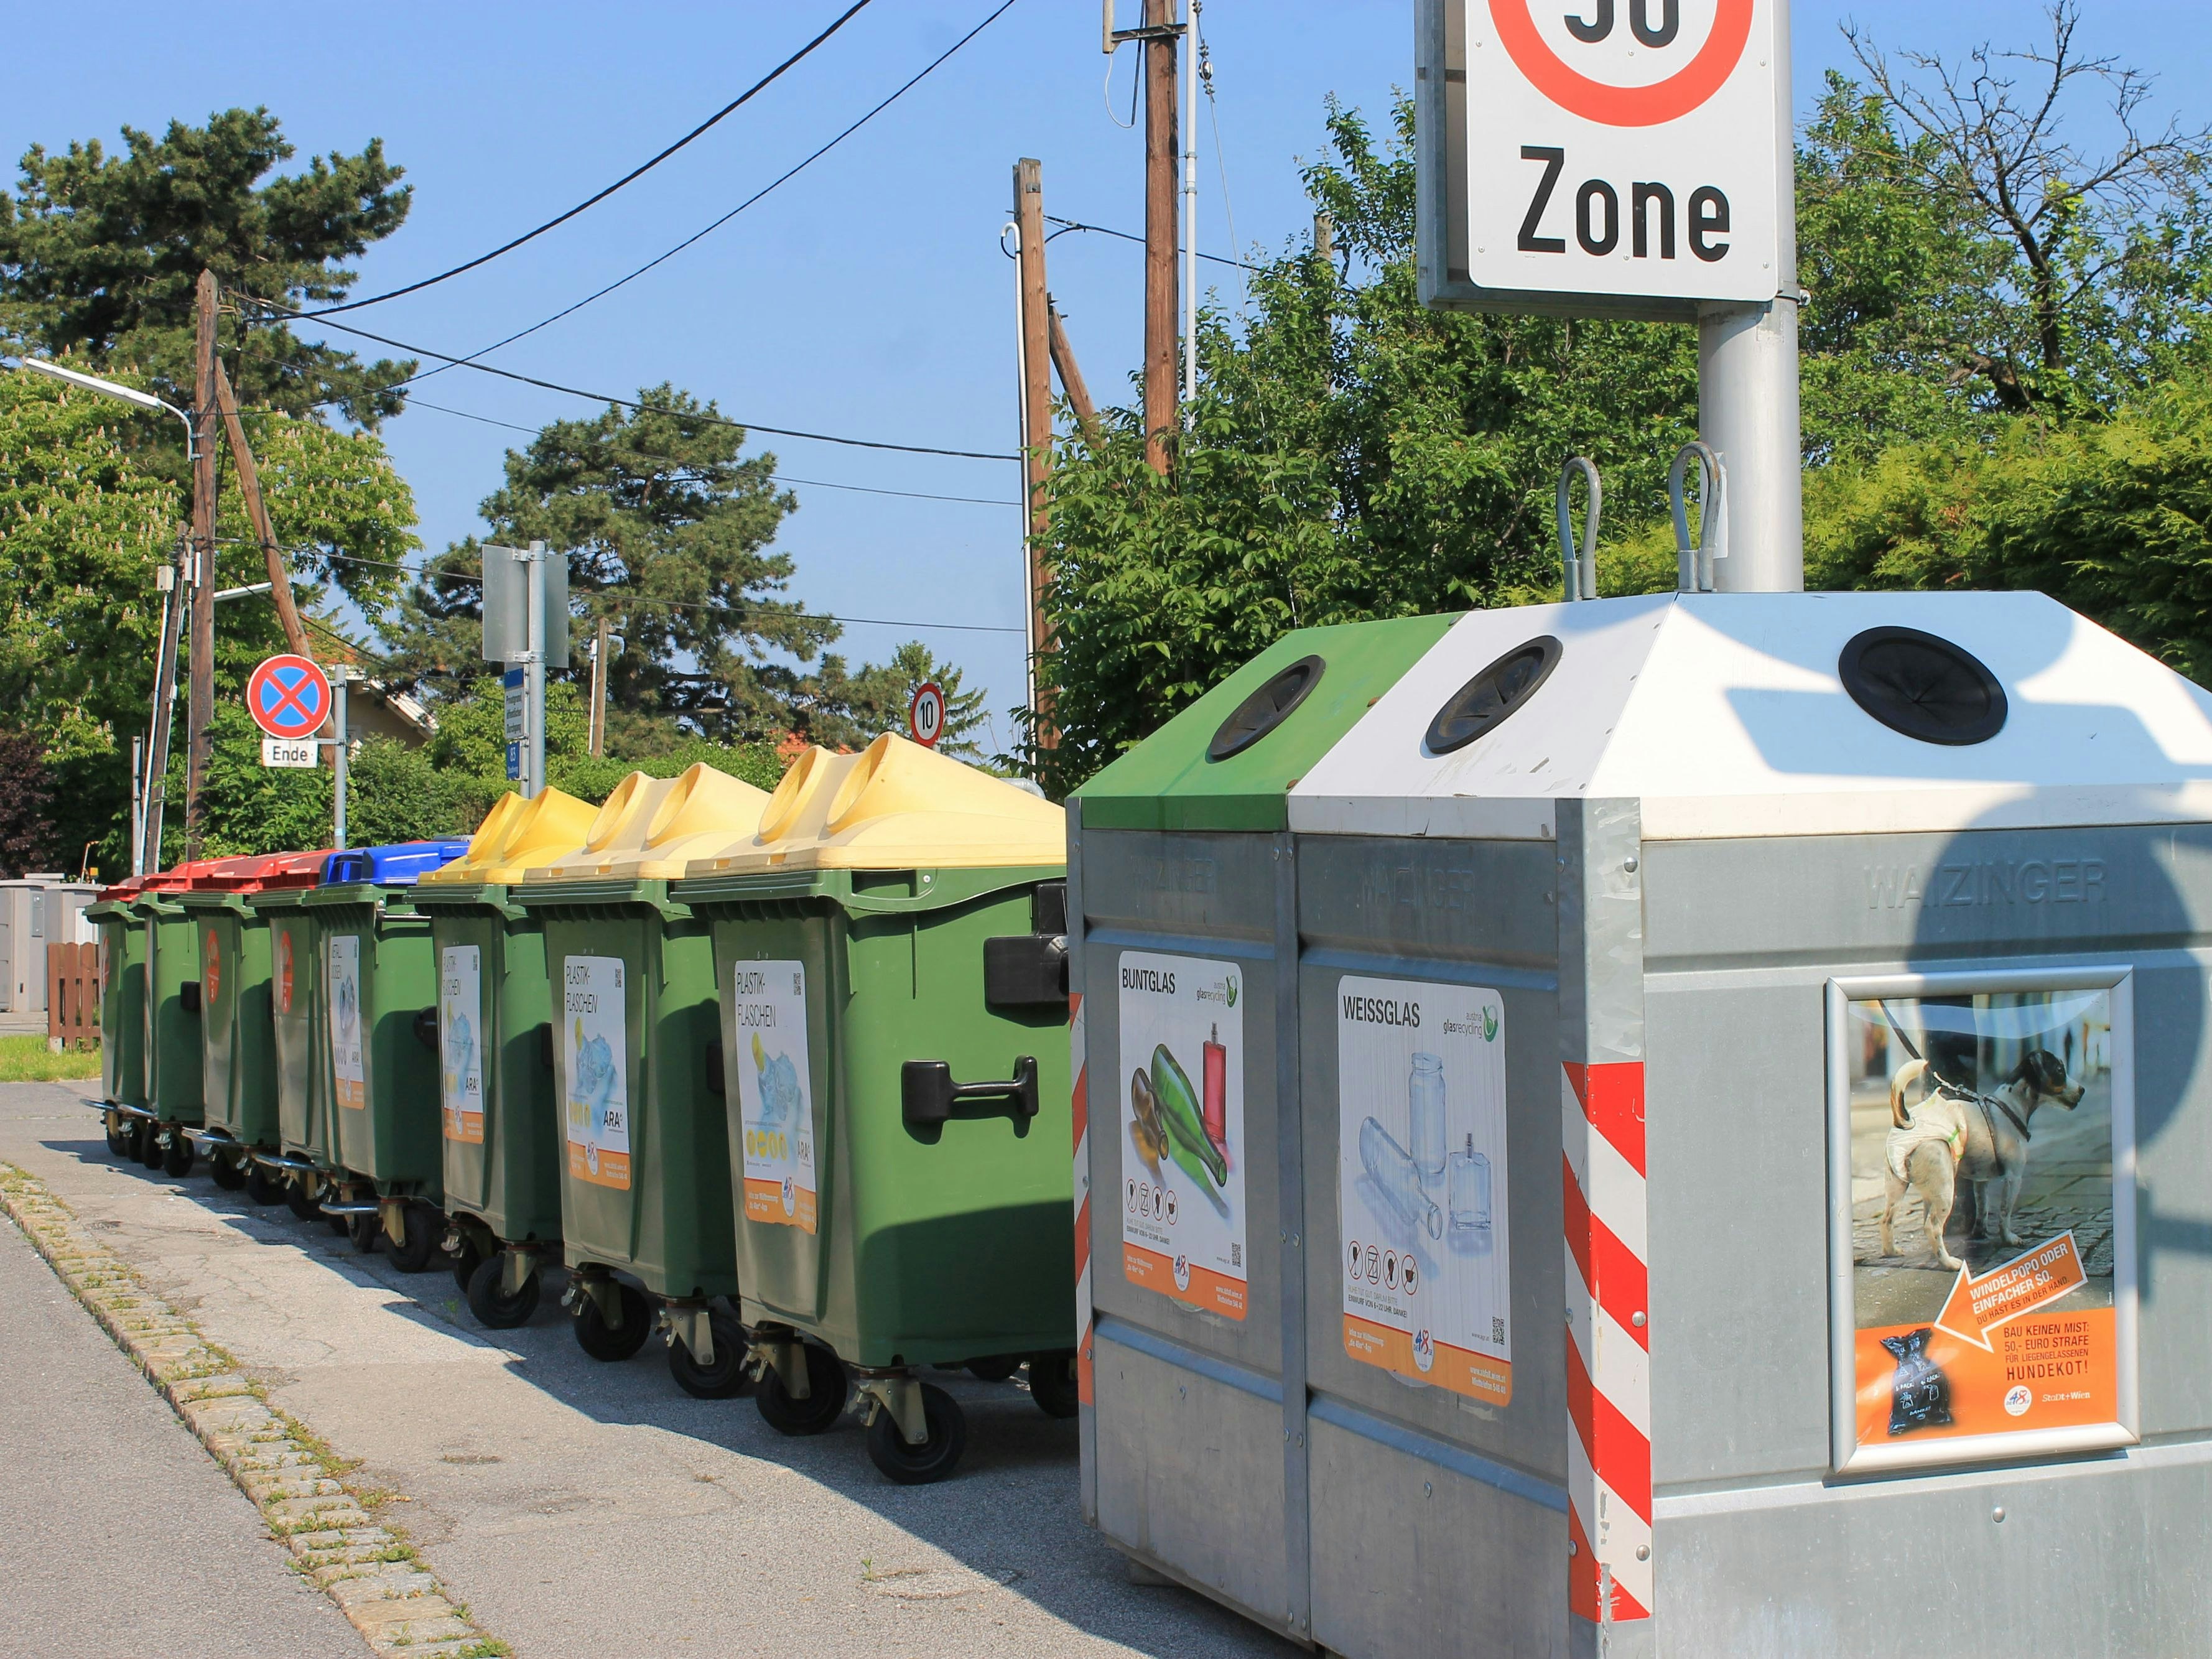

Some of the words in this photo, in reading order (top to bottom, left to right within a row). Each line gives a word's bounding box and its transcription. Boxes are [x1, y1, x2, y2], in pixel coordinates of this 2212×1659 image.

[1517, 145, 1730, 262] Zone
[921, 700, 933, 730] 10
[272, 746, 308, 762] Ende
[737, 972, 765, 994] PLASTIK-
[1122, 968, 1176, 995] BUNTGLAS
[1197, 987, 1225, 1005] glasrecycling
[737, 1004, 776, 1027] FLASCHEN
[1343, 995, 1420, 1028] WEISSGLAS
[1443, 1018, 1482, 1039] glasrecycling
[603, 1110, 620, 1128] ARA
[1970, 1258, 2039, 1300] WINDELPOPO
[2040, 1243, 2068, 1266] ODER
[1973, 1278, 2035, 1314] EINFACHER
[2035, 1270, 2053, 1286] SO.
[1977, 1314, 1987, 1325] DU
[1989, 1304, 2008, 1319] HAST
[2010, 1299, 2021, 1309] ES
[2023, 1294, 2031, 1304] IN
[2033, 1288, 2048, 1301] DER
[2049, 1276, 2070, 1292] HAND.
[2004, 1326, 2022, 1338] BAU
[2026, 1324, 2060, 1336] KEINEN
[2065, 1322, 2089, 1334] MIST:
[1415, 1329, 1429, 1354] 48
[2005, 1341, 2022, 1353] 50,-
[2025, 1337, 2049, 1350] EURO
[2053, 1335, 2089, 1348] STRAFE
[2005, 1353, 2019, 1364] FÜR
[2022, 1349, 2088, 1362] LIEGENGELASSENEN
[2007, 1360, 2088, 1381] HUNDEKOT!
[2009, 1390, 2027, 1405] 48
